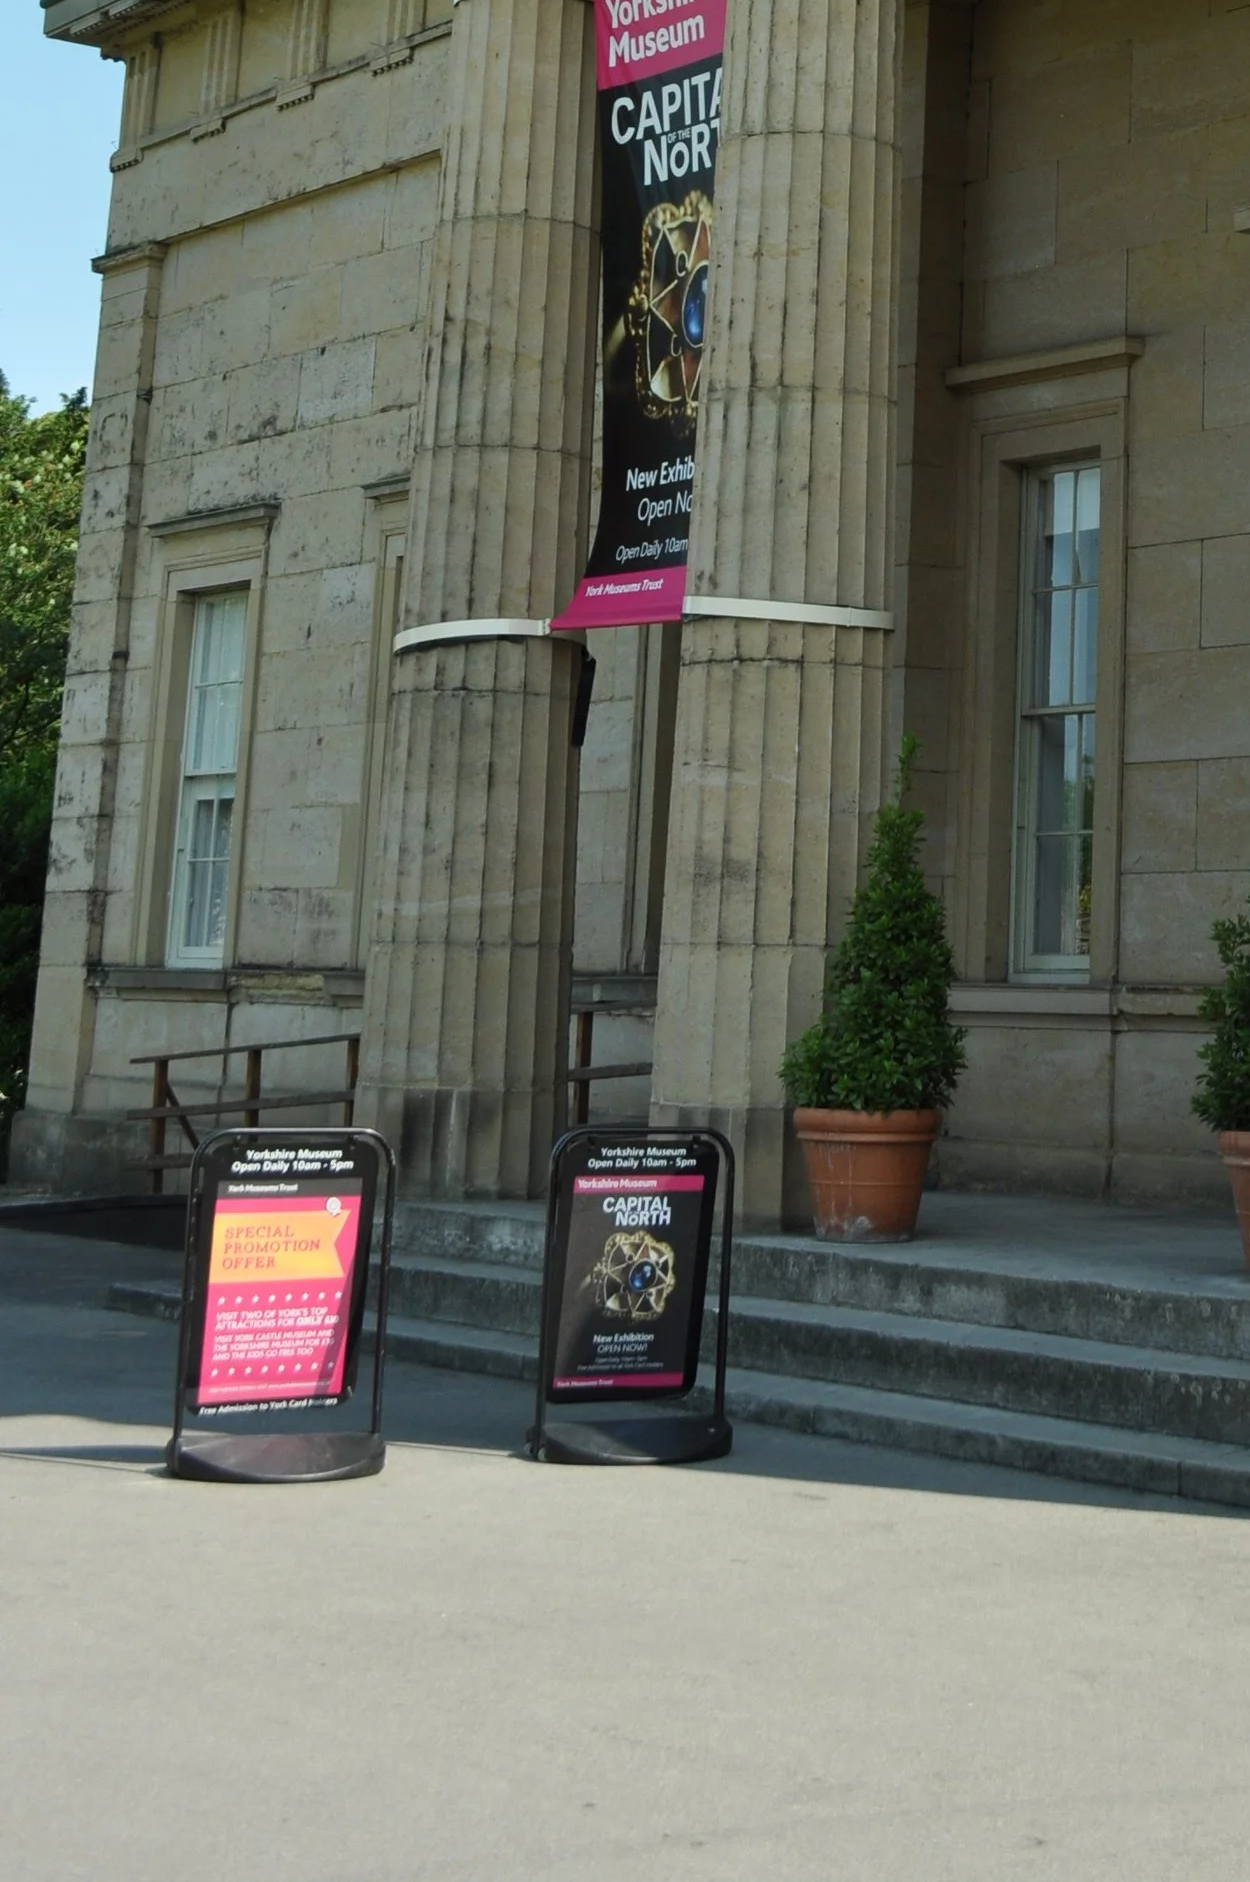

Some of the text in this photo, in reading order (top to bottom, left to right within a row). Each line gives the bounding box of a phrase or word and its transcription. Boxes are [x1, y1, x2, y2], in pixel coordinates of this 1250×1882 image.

[608, 15, 705, 67] Museum
[625, 455, 695, 492] New Exhib
[637, 497, 672, 526] Open
[615, 545, 640, 564] Open
[640, 539, 663, 560] Daily
[585, 578, 664, 597] York Museums Trust
[246, 1148, 343, 1160] Yorkshire Museum
[601, 1147, 687, 1157] Yorkshire Museum
[231, 1161, 261, 1174] Open
[262, 1160, 290, 1174] Daily
[292, 1160, 321, 1171] 10am
[330, 1159, 354, 1171] 5pm
[588, 1158, 613, 1170] Open
[615, 1158, 639, 1170] Daily
[642, 1157, 667, 1167] 10am
[676, 1157, 697, 1168] 5pm
[578, 1179, 657, 1189] Yorkshire Museum
[602, 1196, 671, 1214] CAPITAL
[615, 1209, 671, 1226] NORTH
[225, 1225, 295, 1239] SPECIAL
[223, 1239, 321, 1254] PROMOTION
[222, 1256, 276, 1270] OFFER
[241, 1310, 262, 1320] TWO
[264, 1309, 276, 1318] OF
[310, 1307, 328, 1316] TOP
[215, 1319, 276, 1330] ATTRACTIONS
[593, 1332, 654, 1344] New Exhibition
[597, 1344, 620, 1353] OPEN
[218, 1402, 258, 1413] Admission
[270, 1400, 288, 1409] York
